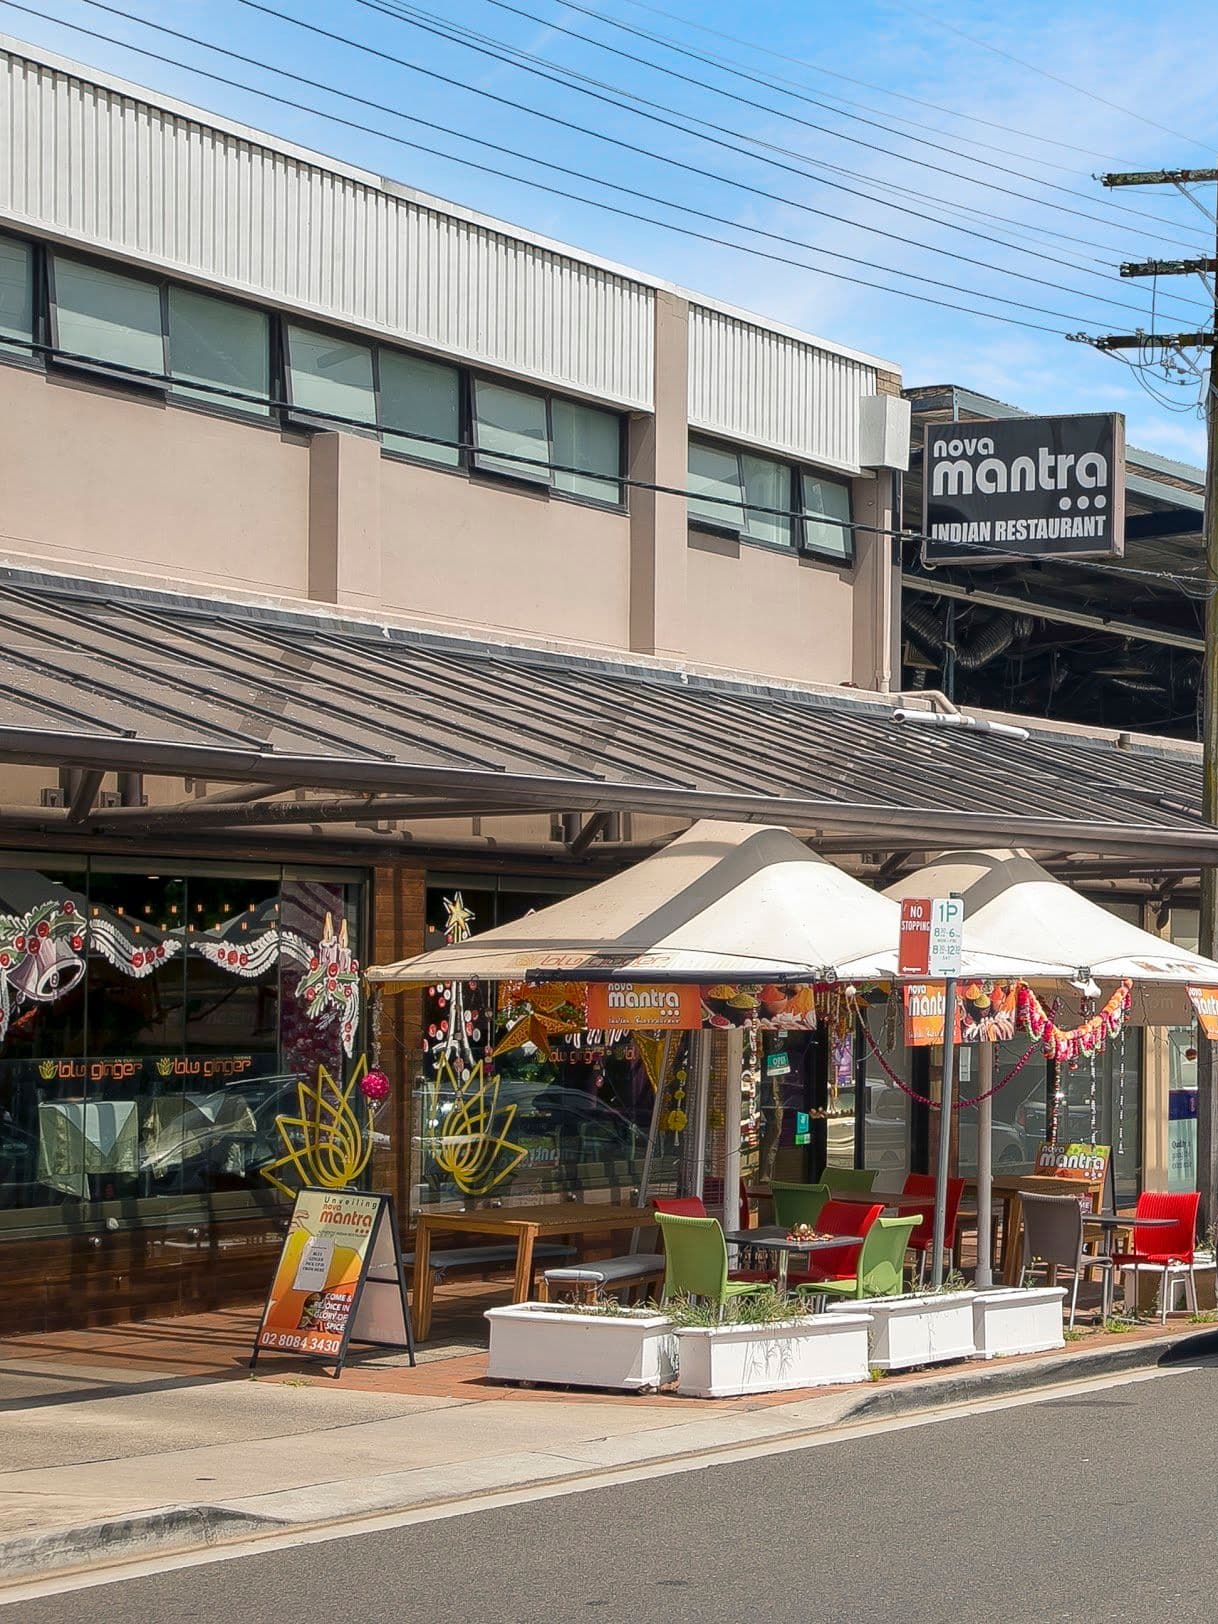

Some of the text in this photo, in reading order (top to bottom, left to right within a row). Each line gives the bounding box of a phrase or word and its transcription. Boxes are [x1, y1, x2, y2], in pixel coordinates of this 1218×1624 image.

[933, 437, 994, 458] nova
[932, 447, 1108, 497] mantra
[931, 515, 1107, 544] INDIAN RESTAURANT
[910, 906, 923, 918] NO
[939, 904, 958, 922] 1P
[901, 921, 931, 932] STOPPING
[607, 982, 633, 992] nova
[907, 985, 926, 994] nova
[608, 989, 680, 1008] mantra
[91, 1061, 142, 1079] ginger
[203, 1058, 250, 1077] ginger
[1042, 1145, 1065, 1154] nova
[1040, 1152, 1105, 1171] mantra
[322, 1204, 342, 1212] nova
[324, 1196, 377, 1210] Unveiling
[319, 1210, 372, 1228] mantra
[326, 1292, 346, 1302] COME
[314, 1300, 350, 1312] REJOICE IN
[314, 1309, 336, 1320] GLORY
[262, 1332, 340, 1352] 02 8084 3430
